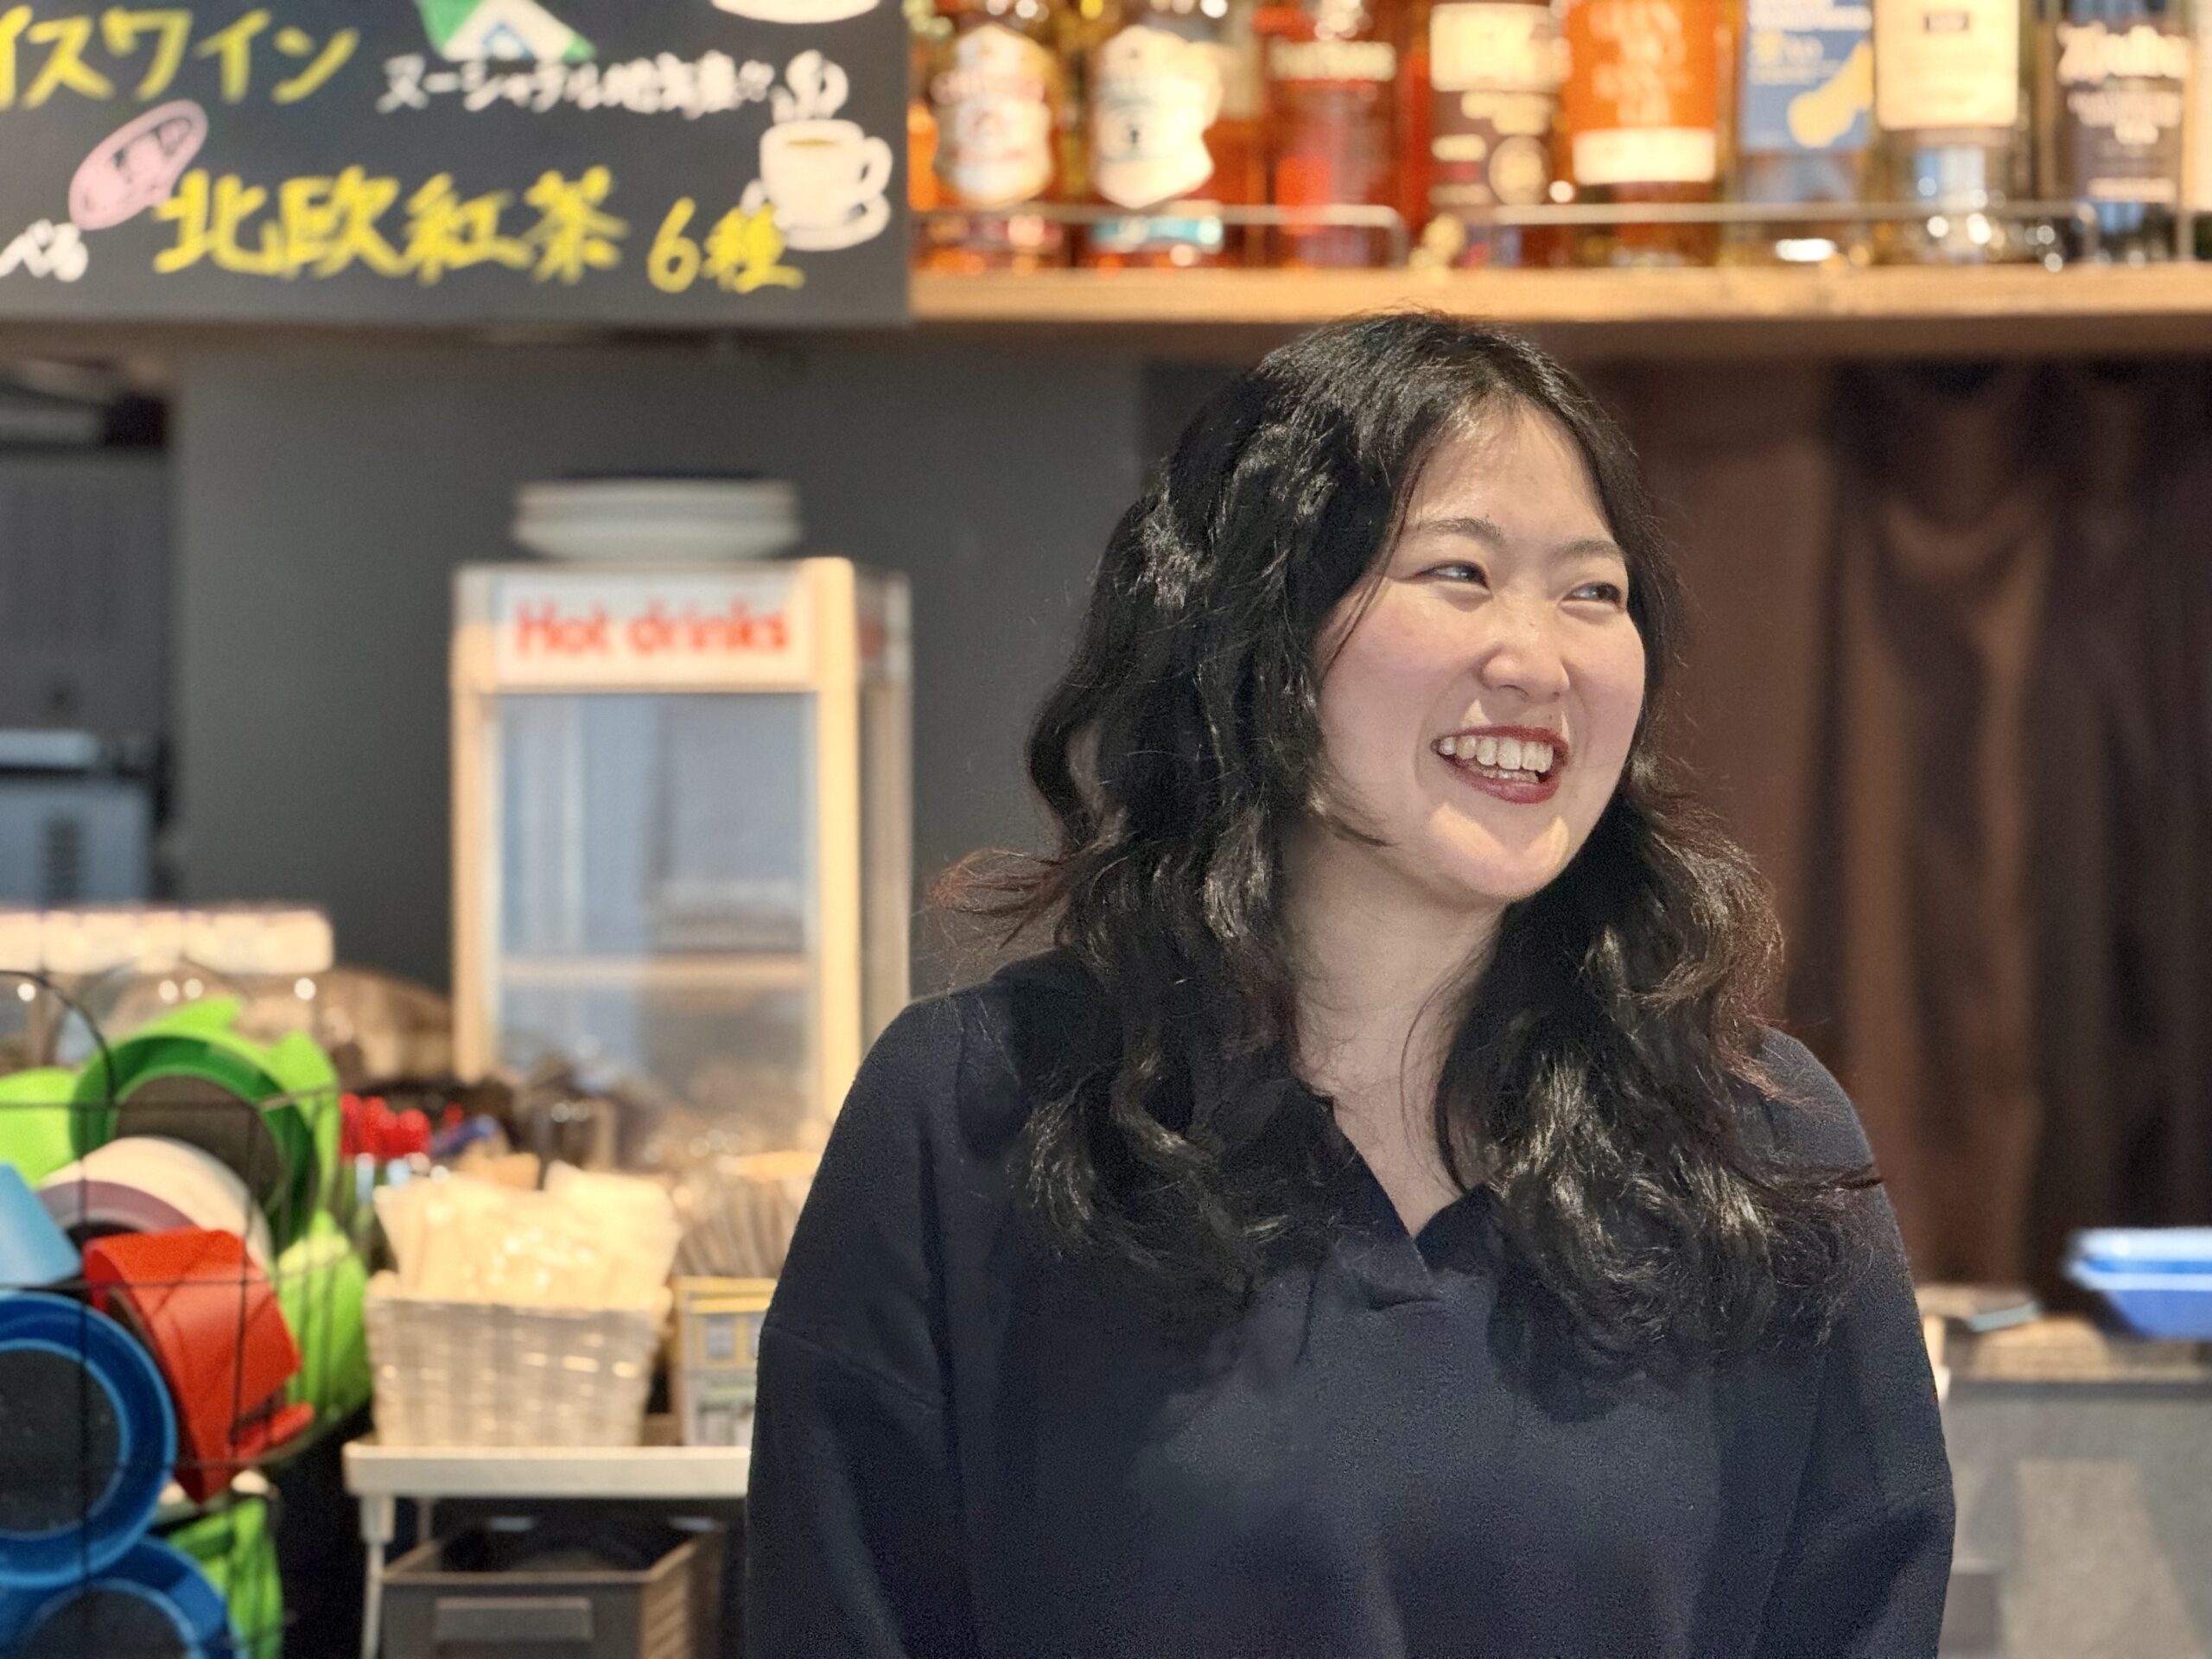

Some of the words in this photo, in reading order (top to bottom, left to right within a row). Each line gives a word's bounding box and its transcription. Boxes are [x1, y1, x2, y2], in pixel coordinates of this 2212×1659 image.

[154, 164, 629, 286] 北欧紅茶
[515, 598, 609, 657] Hot
[626, 598, 789, 660] drinks
